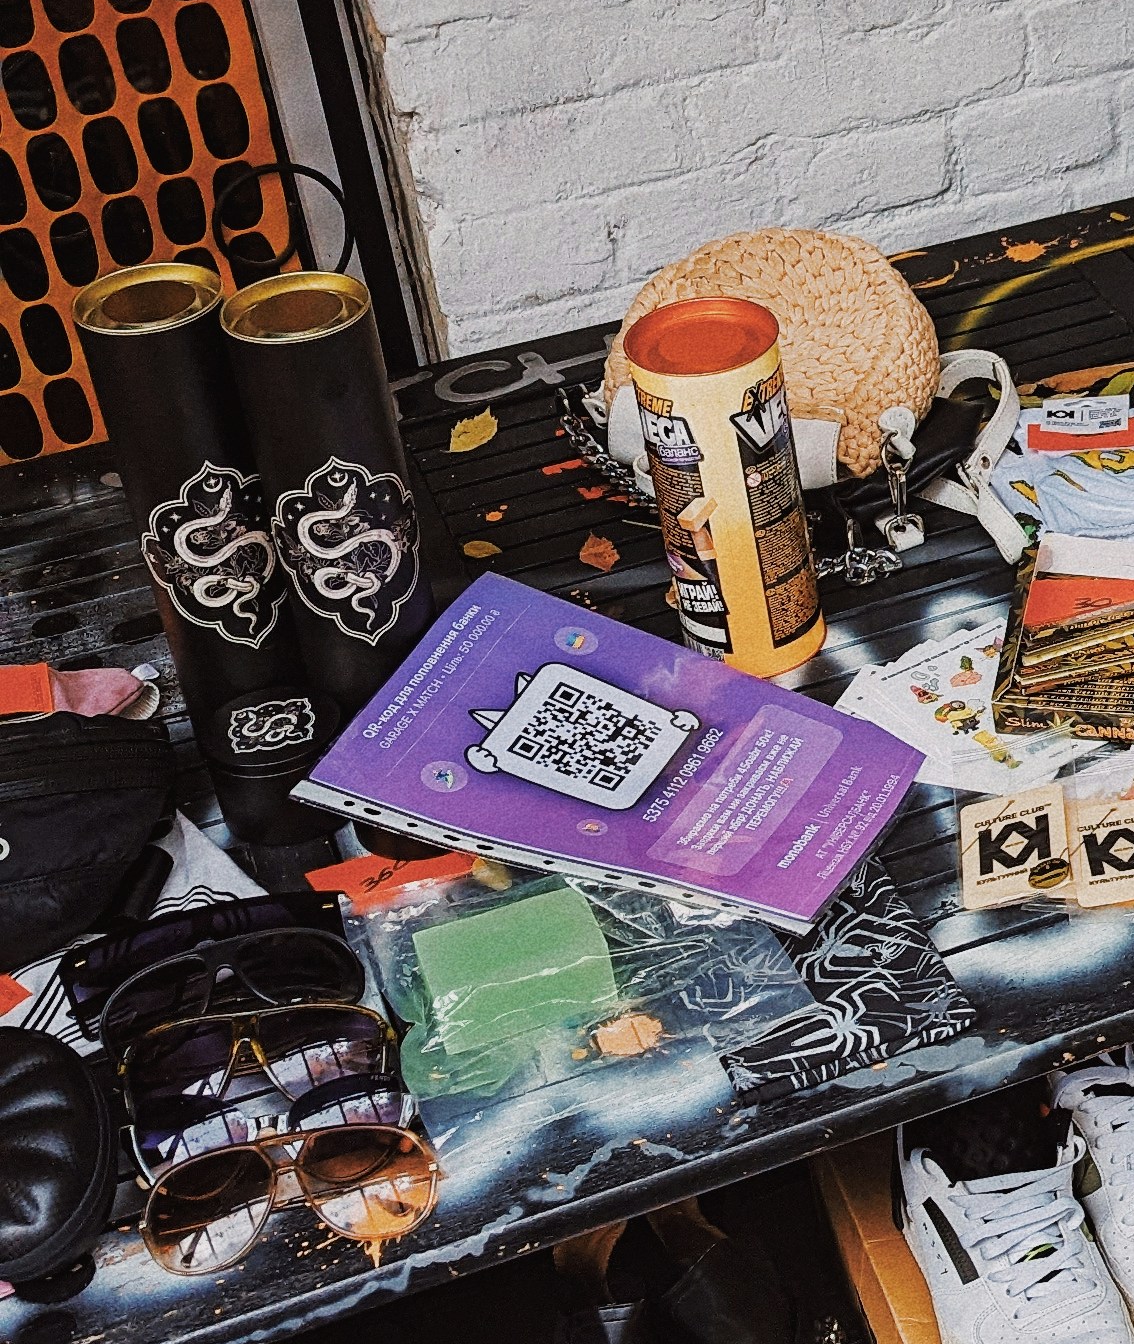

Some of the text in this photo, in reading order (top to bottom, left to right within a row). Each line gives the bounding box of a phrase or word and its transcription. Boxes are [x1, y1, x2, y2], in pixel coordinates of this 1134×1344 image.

[363, 705, 399, 739] QR-код
[394, 685, 415, 707] для
[452, 604, 482, 630] банки
[379, 714, 413, 749] GARAGE
[414, 679, 444, 710] MATCH
[642, 727, 724, 823] 5375 4112 0961 9662
[777, 823, 821, 869] monobank
[842, 766, 863, 786] Bank
